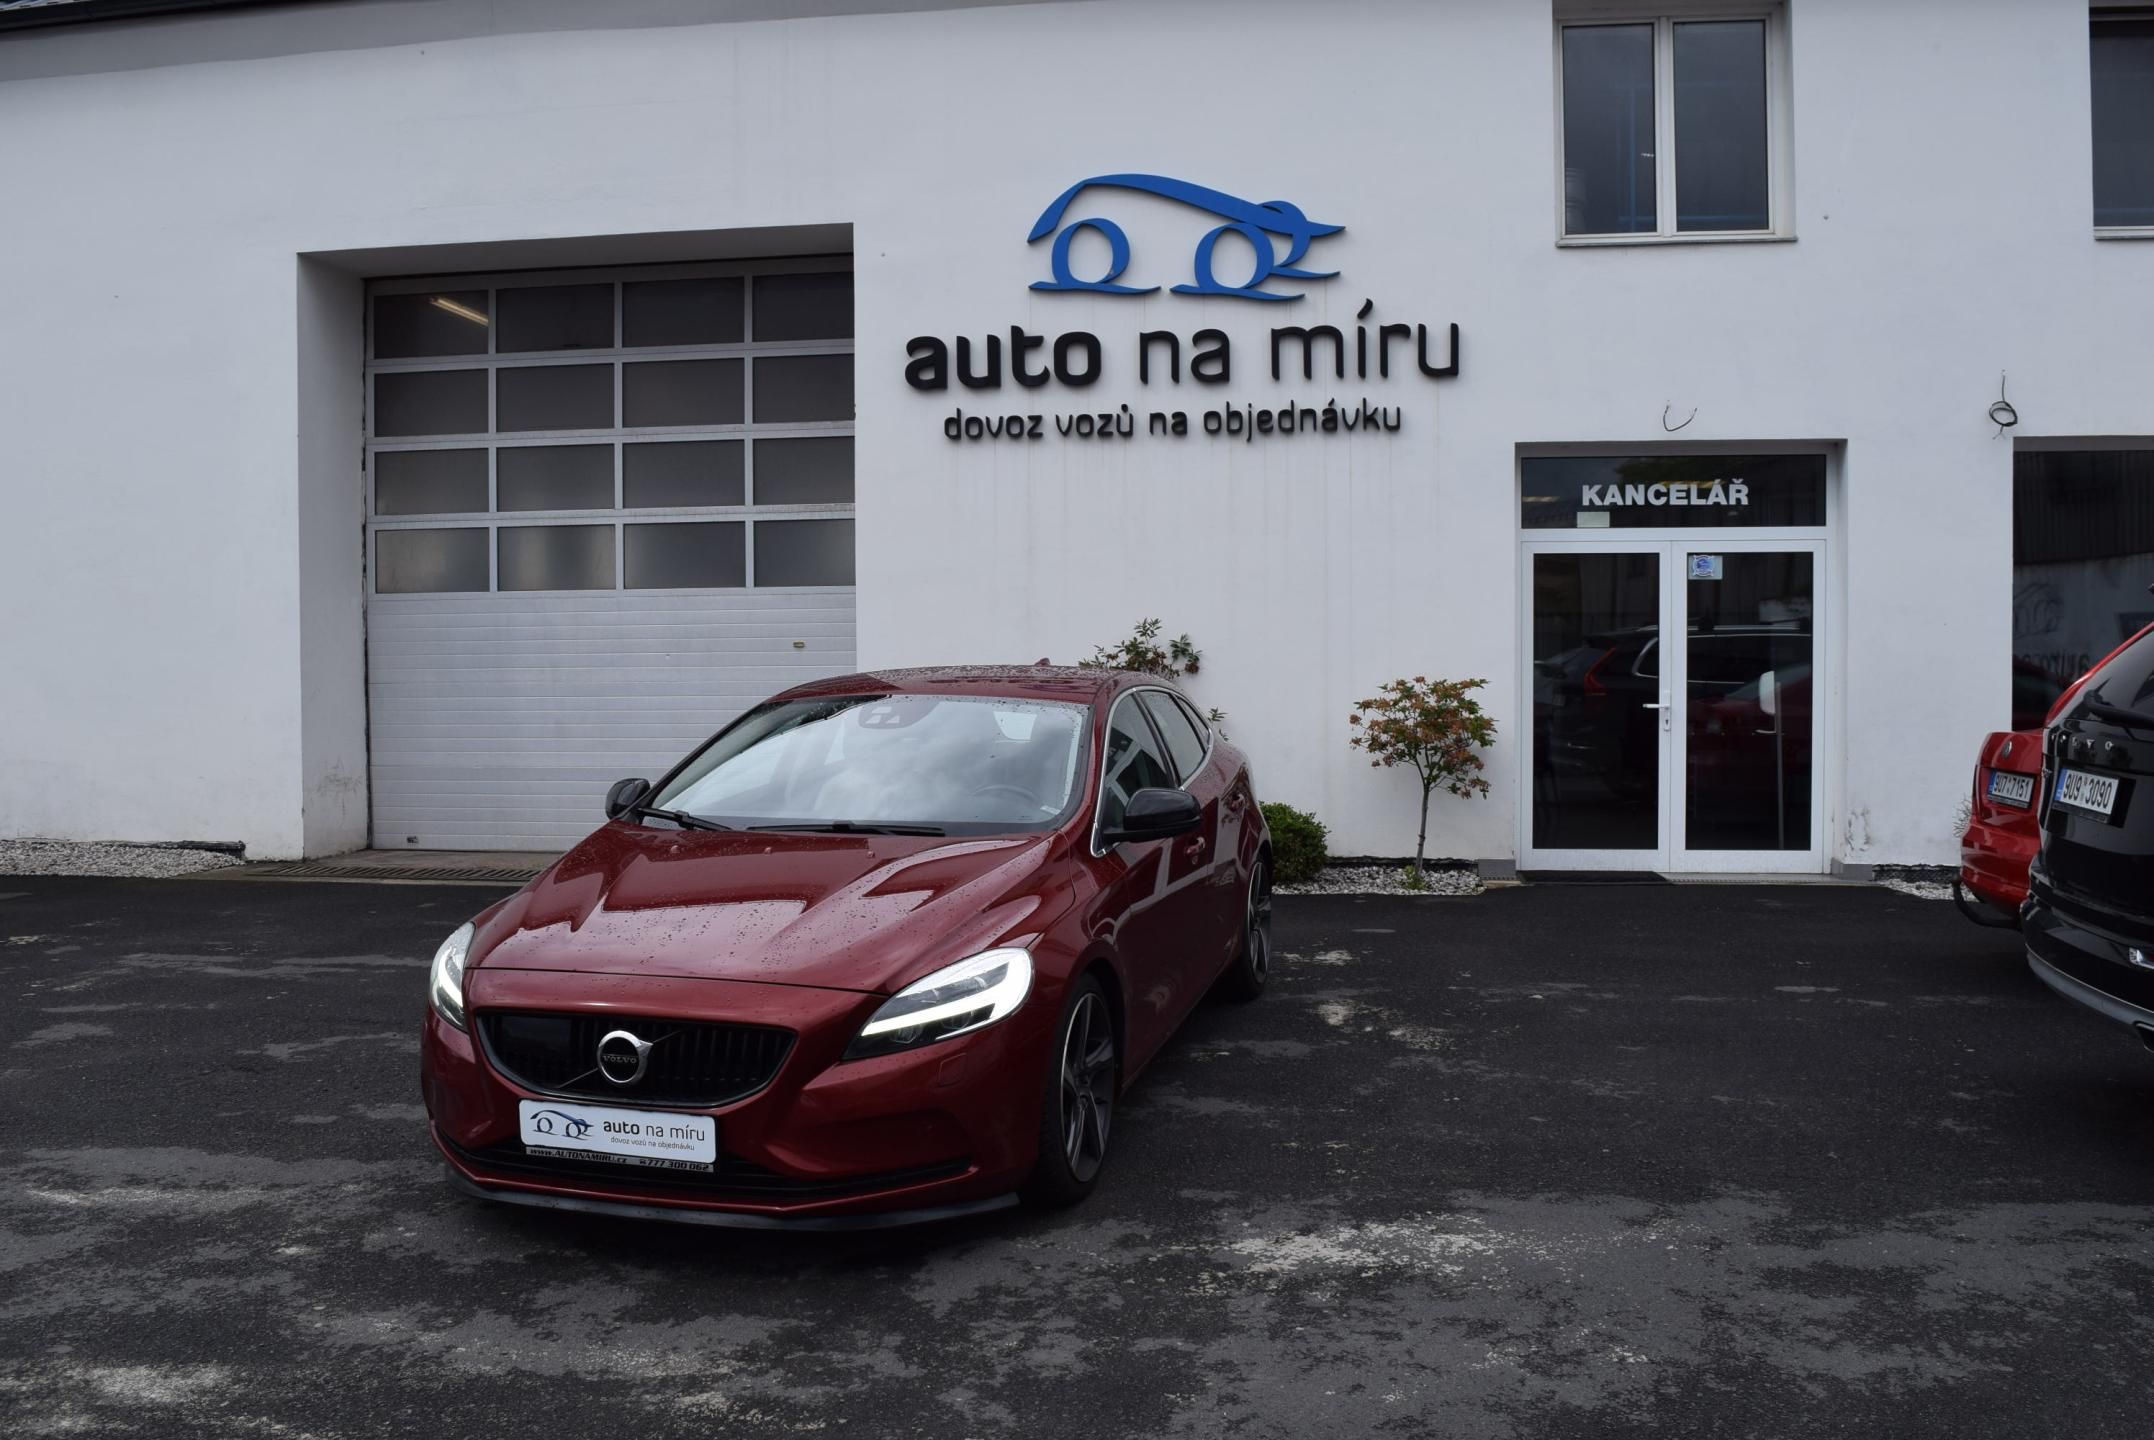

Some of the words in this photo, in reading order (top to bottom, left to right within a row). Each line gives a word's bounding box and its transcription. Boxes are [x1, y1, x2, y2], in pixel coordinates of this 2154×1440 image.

[904, 325, 1101, 390] auto
[1139, 327, 1231, 385] na
[1270, 298, 1460, 380] míru
[944, 407, 1044, 441] dovoz
[1055, 403, 1134, 437] vozů
[1149, 409, 1188, 435] na
[1203, 397, 1401, 442] objednávku
[1581, 478, 1750, 507] KANCELÁŘ
[2063, 773, 2083, 801] 9U9
[2085, 777, 2113, 809] 3090
[602, 1055, 637, 1064] VOLVO
[603, 1120, 640, 1136] auto
[645, 1124, 664, 1138] na
[669, 1124, 705, 1141] míru
[611, 1136, 630, 1145] dovoz
[658, 1140, 695, 1151] objednávku
